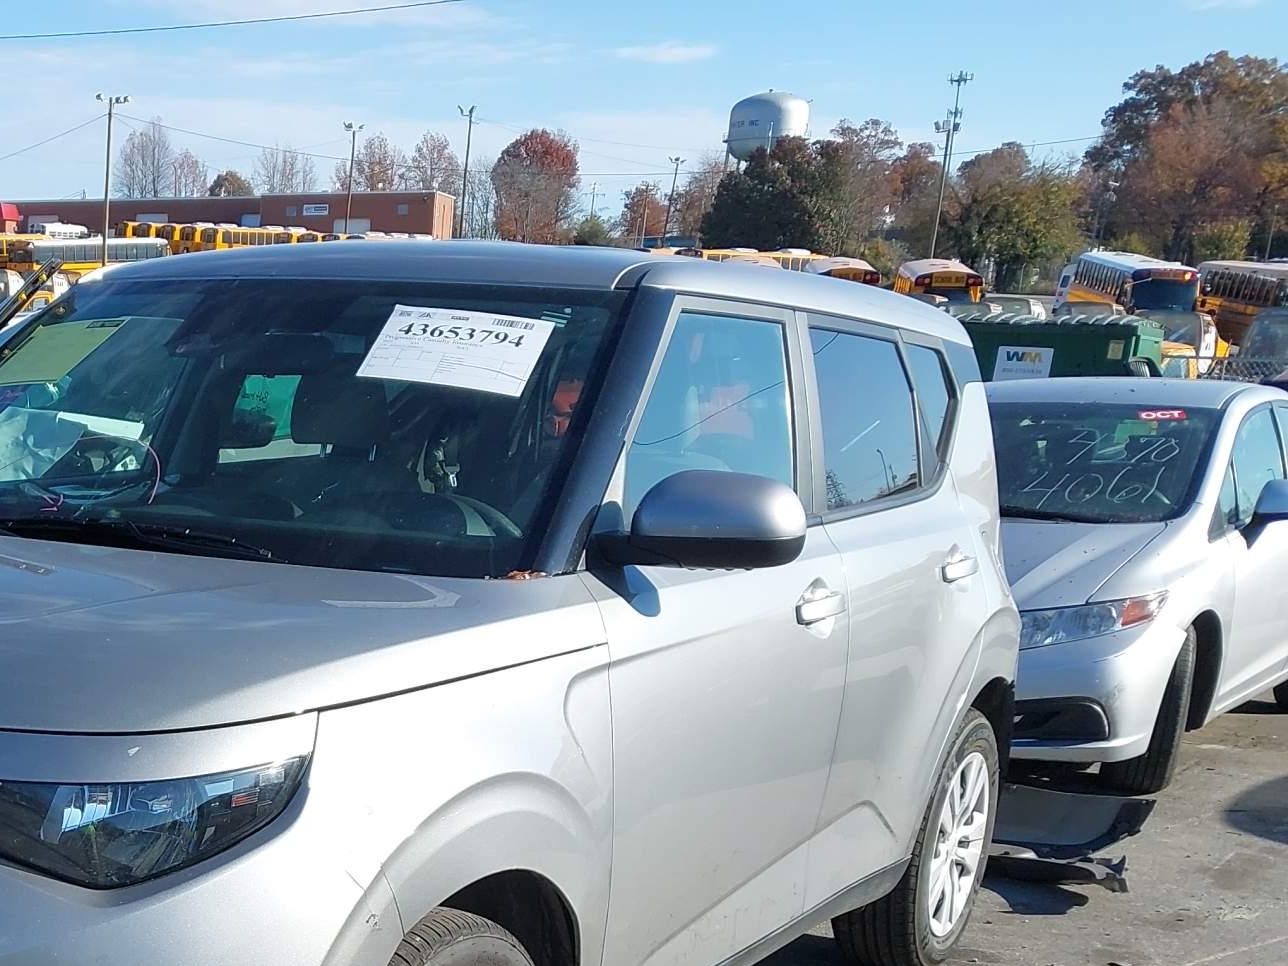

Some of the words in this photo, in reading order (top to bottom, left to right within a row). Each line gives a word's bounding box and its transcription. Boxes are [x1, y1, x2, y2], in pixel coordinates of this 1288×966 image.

[398, 322, 525, 348] 43653794
[1006, 350, 1042, 362] WM
[1140, 410, 1184, 419] OCT
[1018, 466, 1166, 509] 4061
